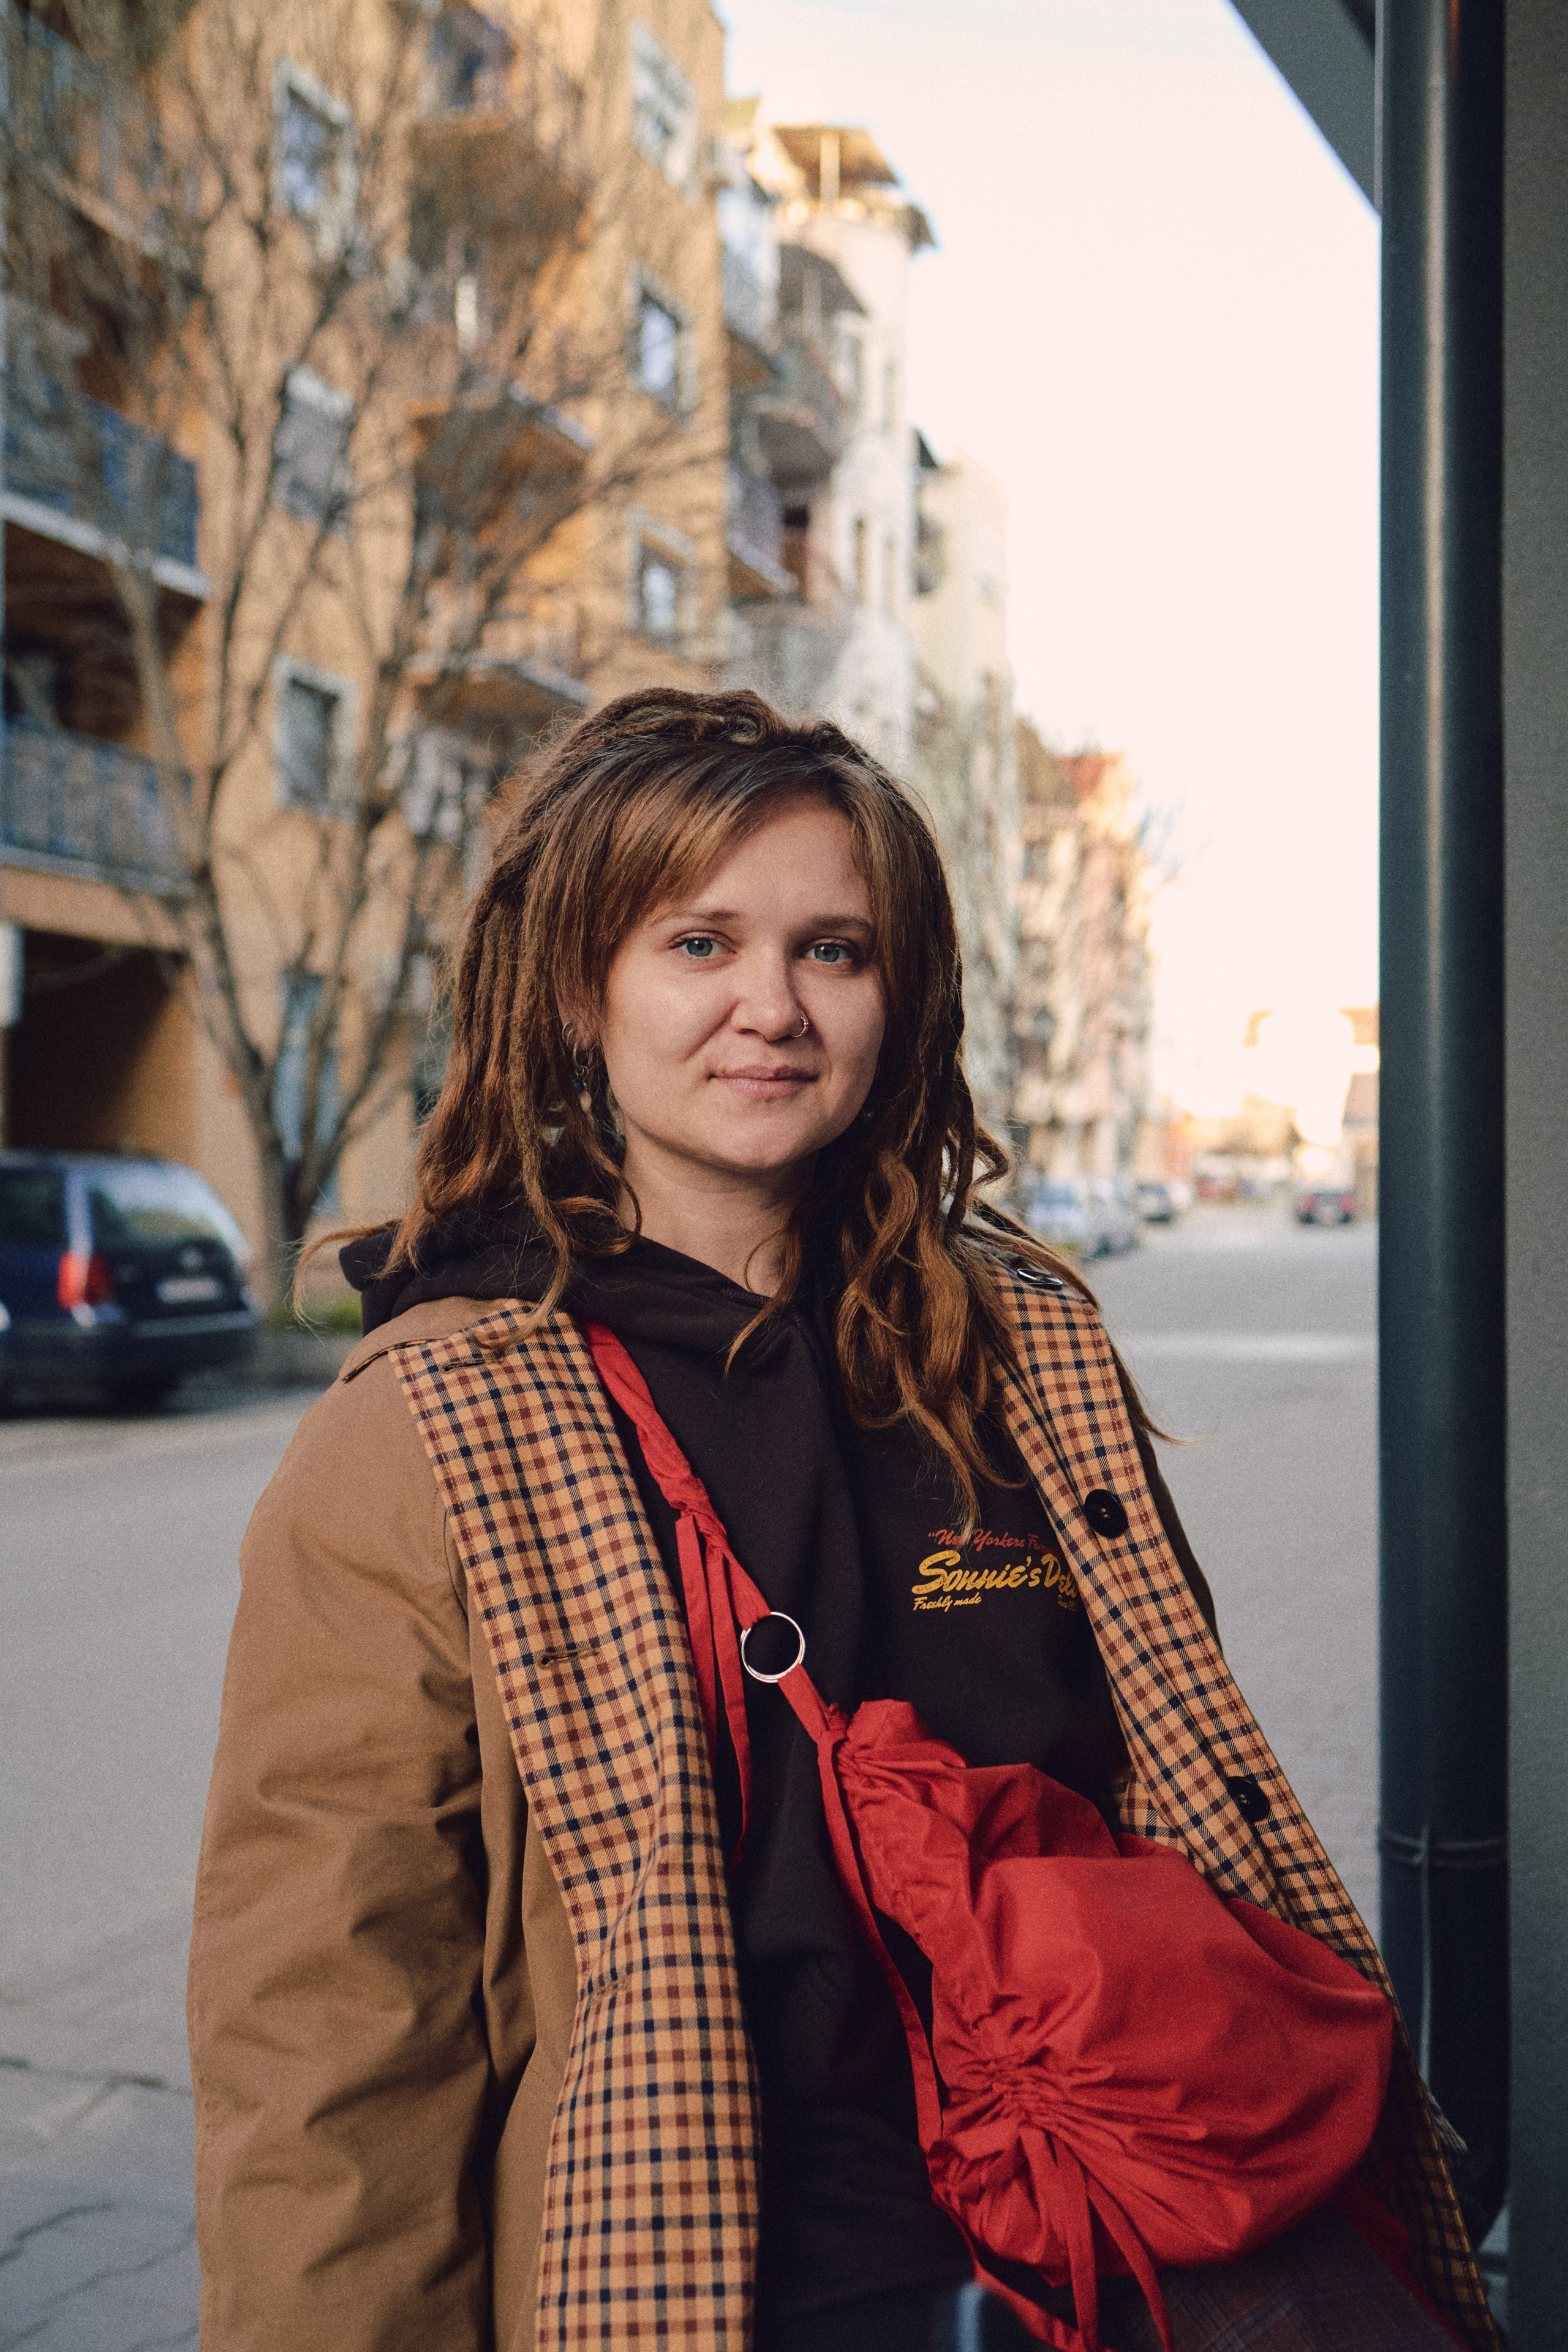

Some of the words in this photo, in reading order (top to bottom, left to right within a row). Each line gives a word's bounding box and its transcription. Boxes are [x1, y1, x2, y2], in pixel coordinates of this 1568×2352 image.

[973, 1528, 1025, 1551] Yorkers
[911, 1550, 1041, 1594] Sonnie's
[913, 1596, 953, 1612] Freshly
[954, 1592, 982, 1606] made
